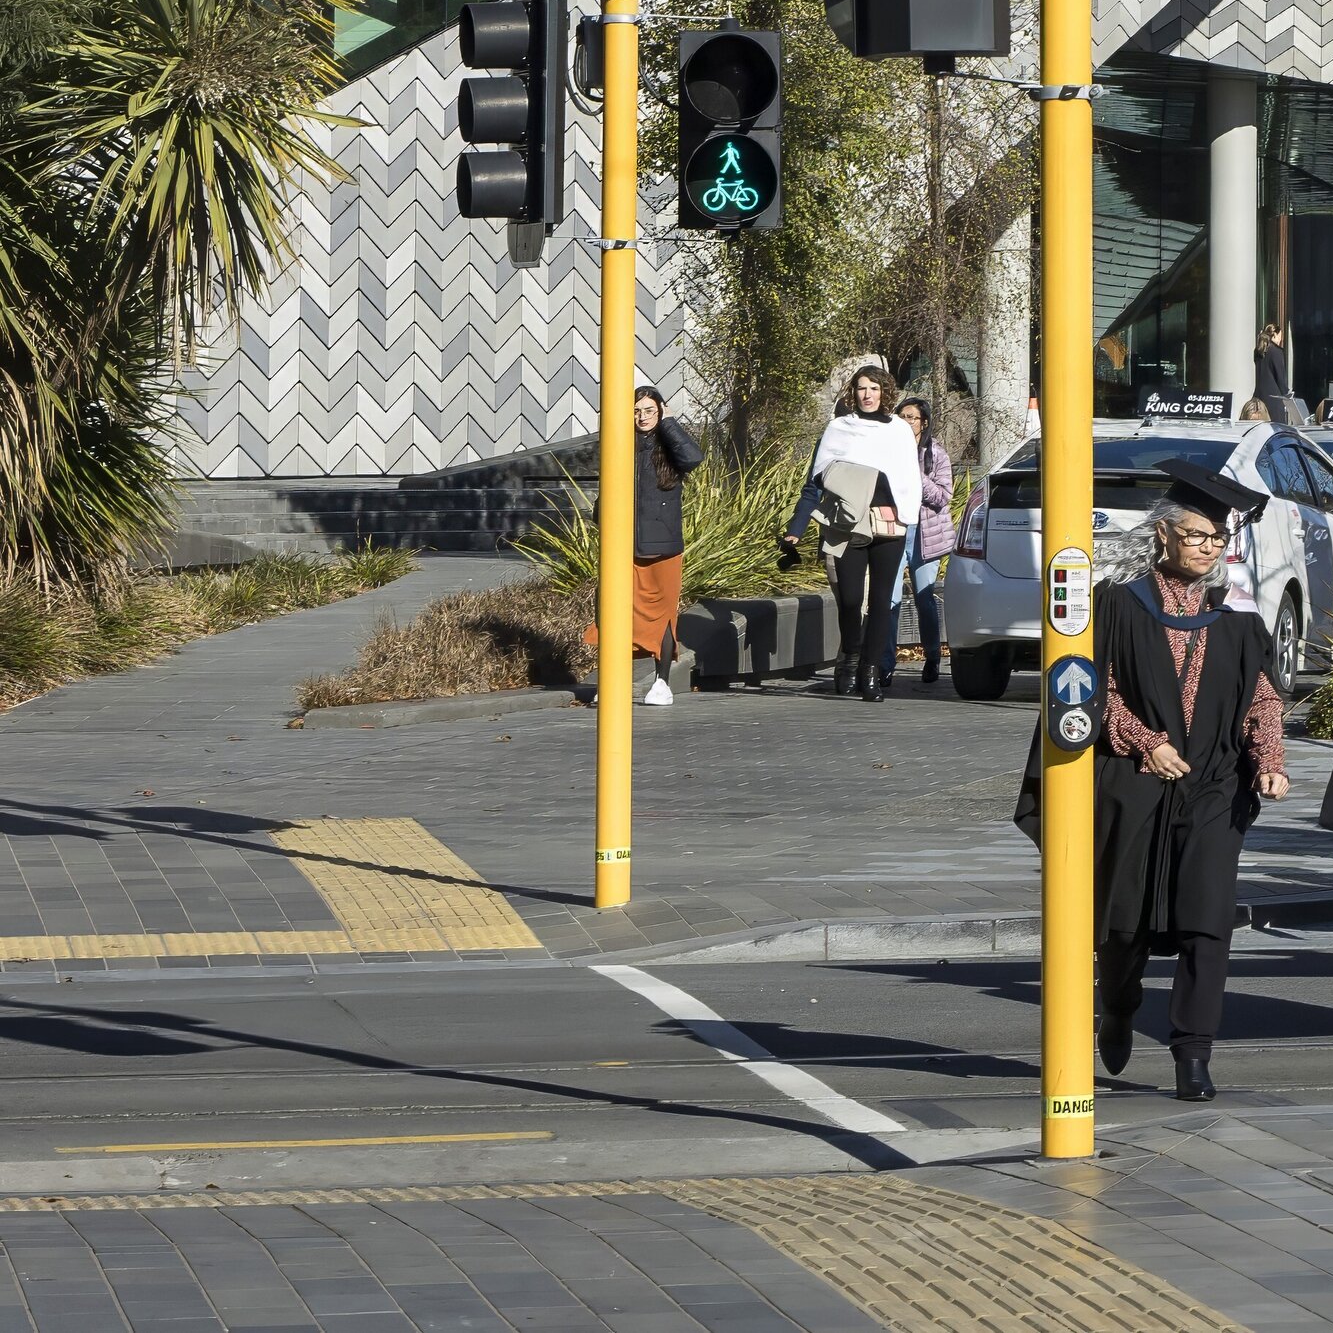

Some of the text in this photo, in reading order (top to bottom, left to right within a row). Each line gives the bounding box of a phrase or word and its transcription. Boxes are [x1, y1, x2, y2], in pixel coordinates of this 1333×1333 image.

[1145, 402, 1224, 415] KING CABS
[1053, 1099, 1094, 1113] DANGE
